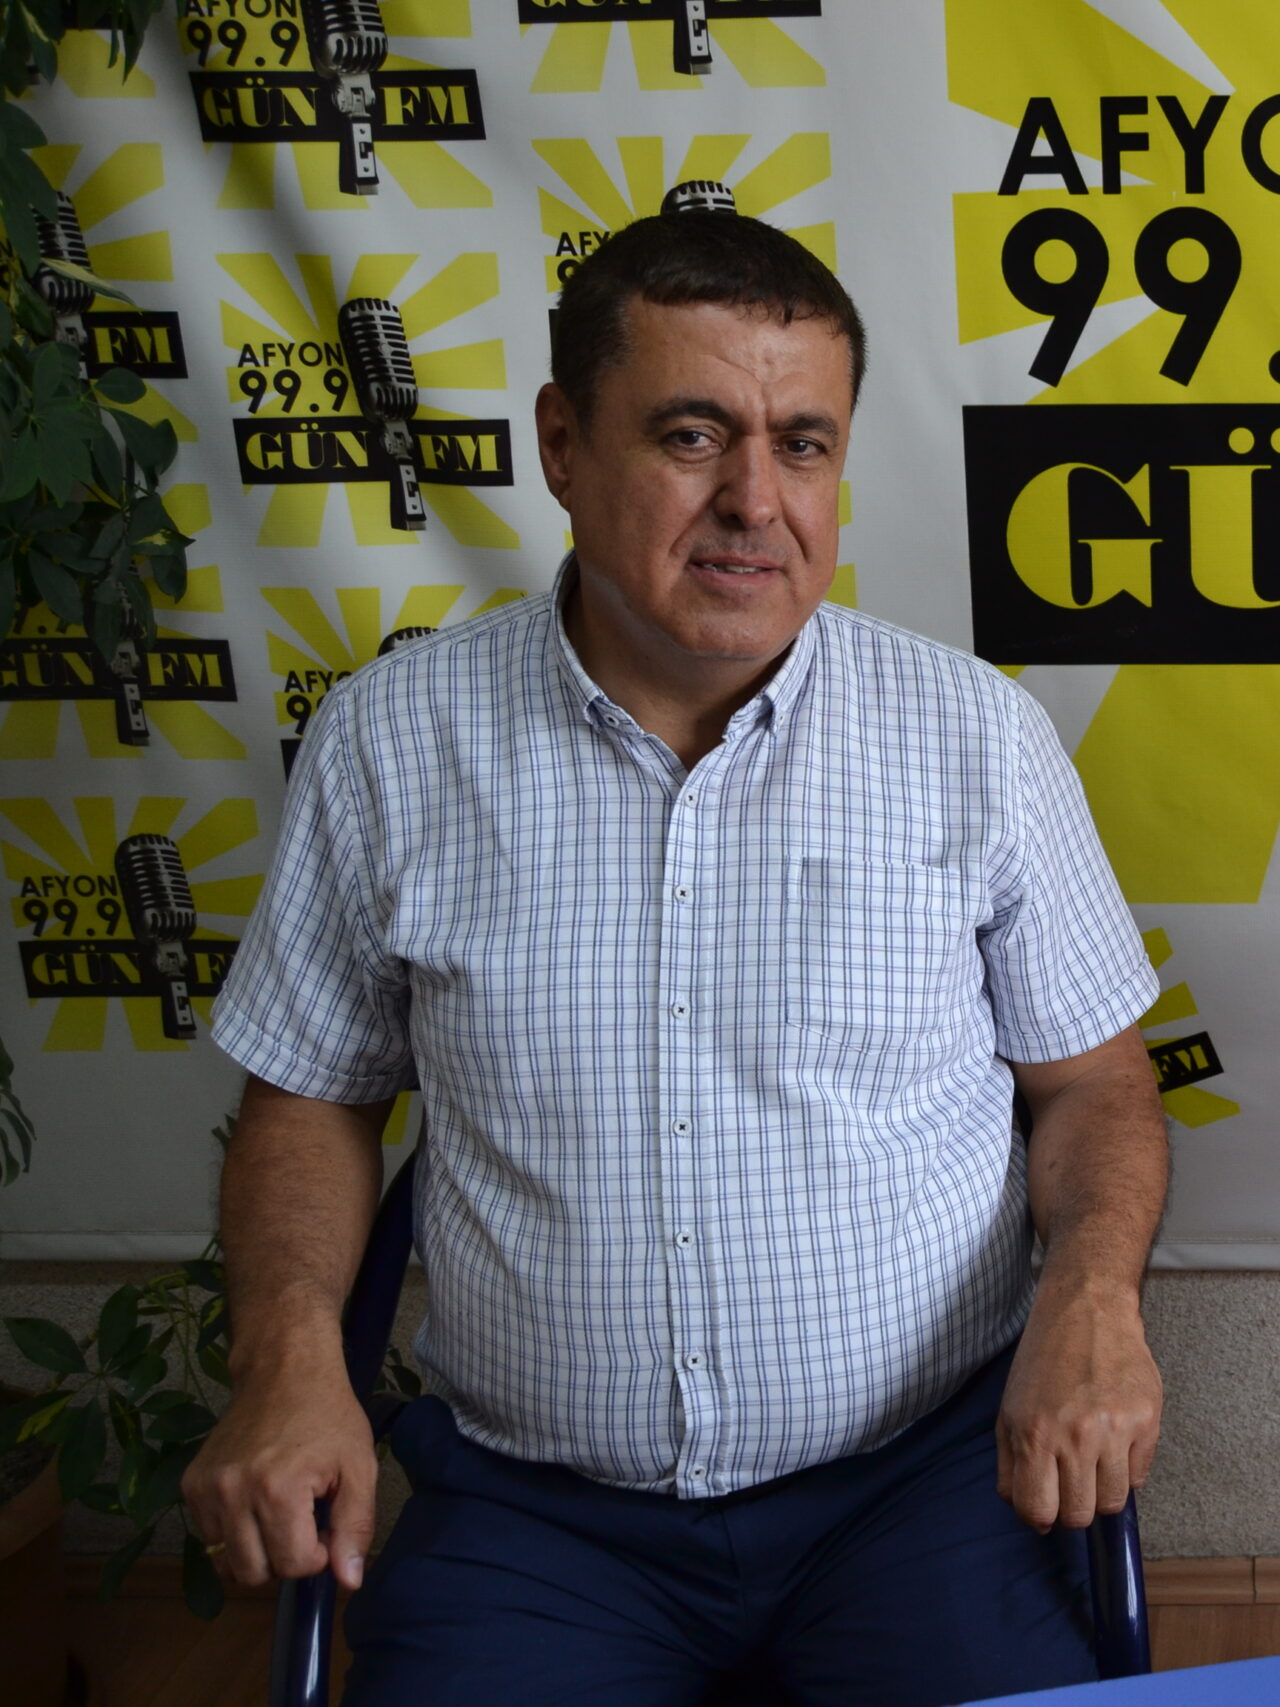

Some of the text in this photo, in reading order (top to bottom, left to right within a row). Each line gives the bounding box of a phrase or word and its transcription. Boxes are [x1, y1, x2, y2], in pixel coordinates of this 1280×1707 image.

[186, 0, 297, 18] AFYON
[187, 20, 299, 67] 99.9
[203, 77, 475, 128] GÜN FM
[555, 231, 611, 257] AFY
[93, 327, 175, 364] FM
[238, 341, 348, 368] AFYON
[239, 368, 349, 414] 99.9
[246, 422, 504, 472] GÜN FM
[147, 652, 224, 688] FM
[284, 670, 352, 693] AFY
[20, 875, 118, 898] AFYON
[23, 898, 122, 937] 99.9
[31, 944, 143, 985] GÜN
